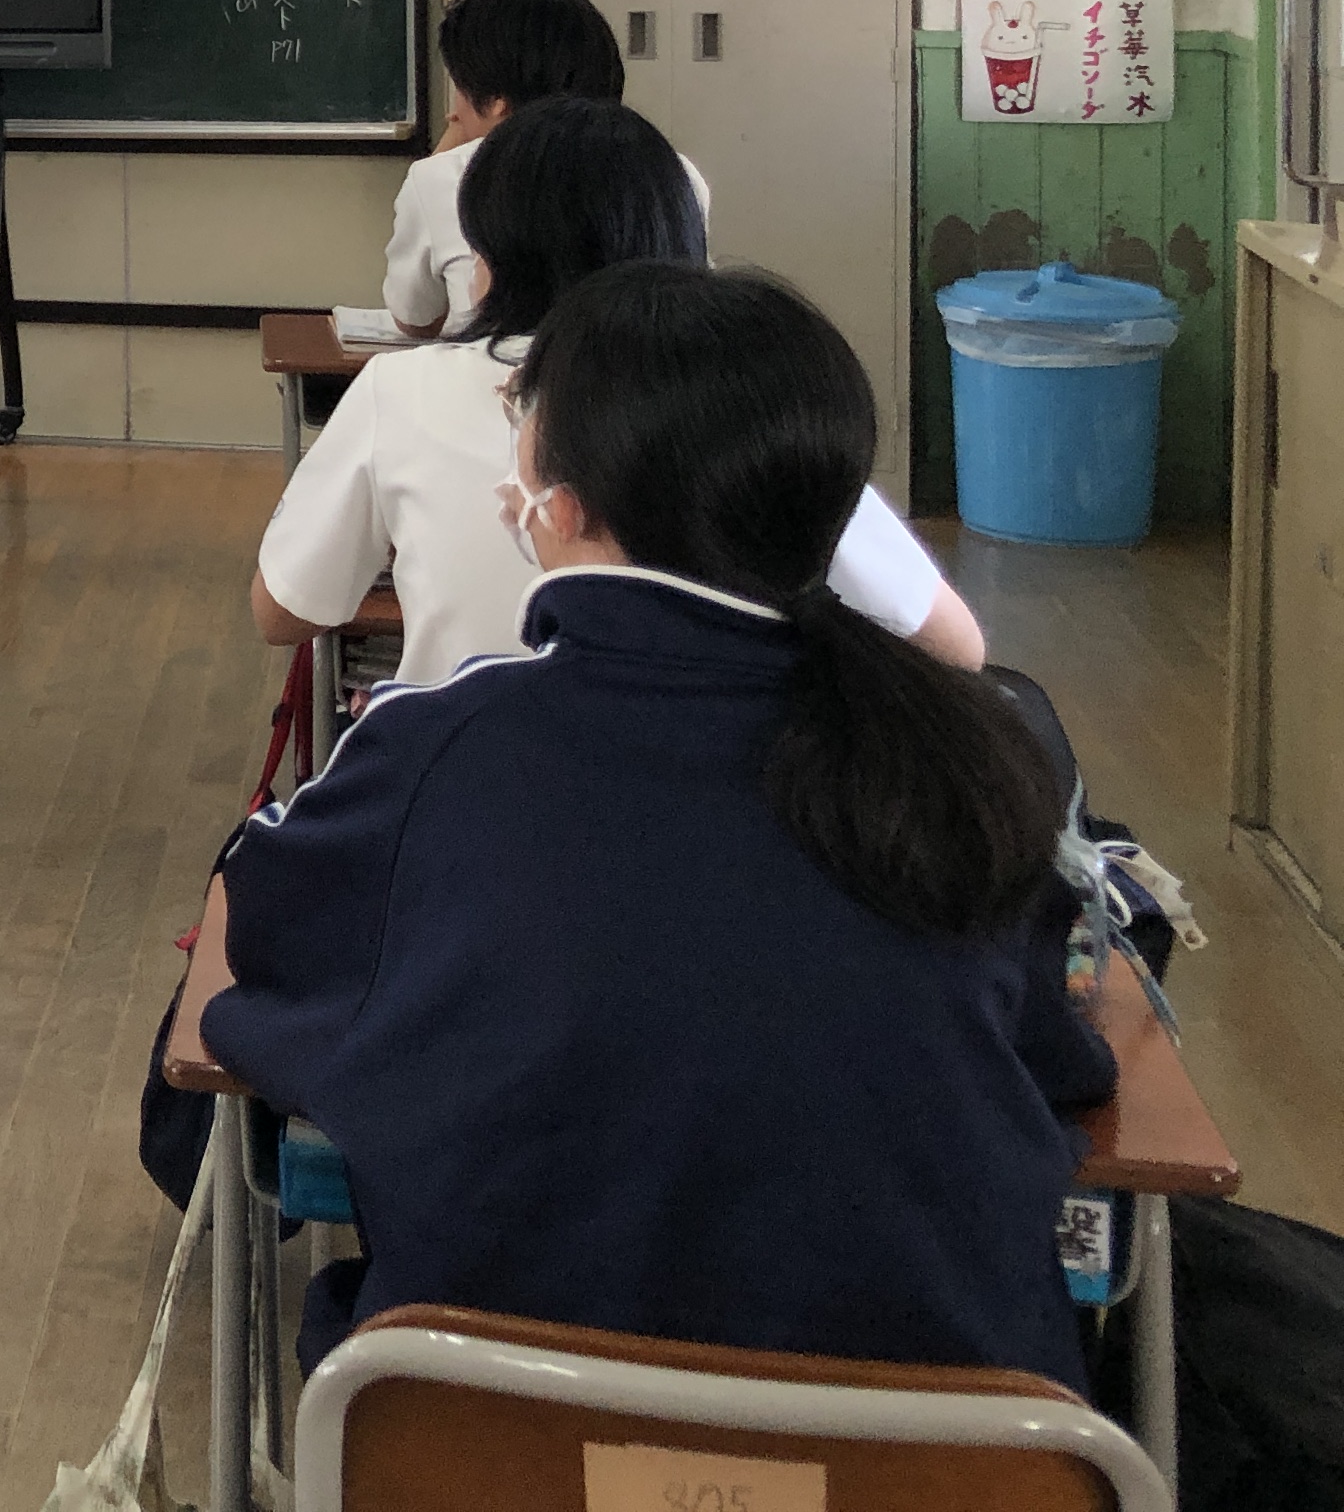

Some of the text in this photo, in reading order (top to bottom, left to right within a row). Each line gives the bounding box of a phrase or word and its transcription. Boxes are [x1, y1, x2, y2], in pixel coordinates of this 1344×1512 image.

[1081, 1, 1108, 120] イチゴソーダ
